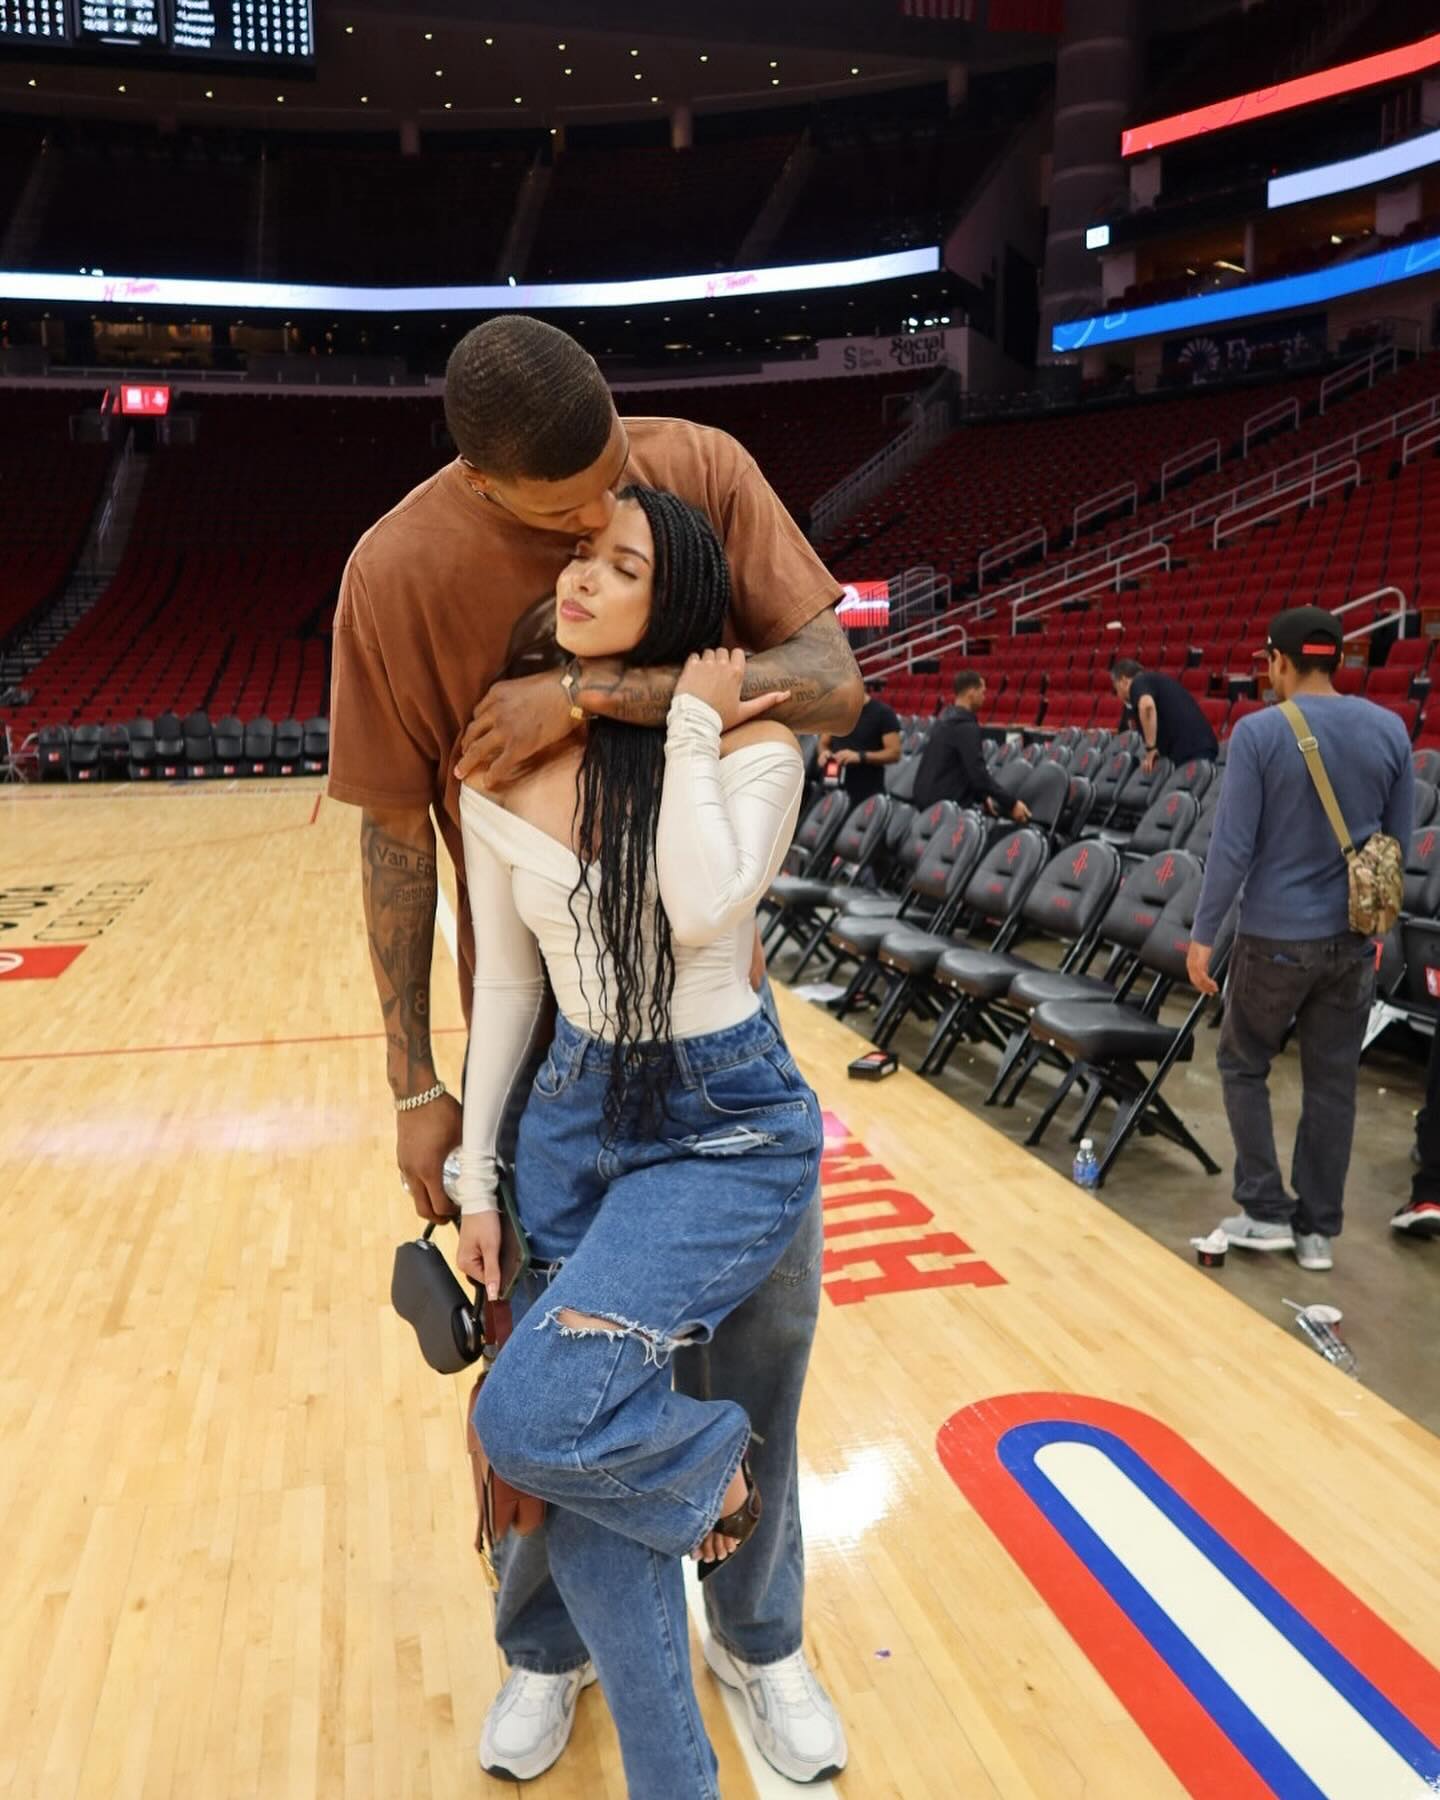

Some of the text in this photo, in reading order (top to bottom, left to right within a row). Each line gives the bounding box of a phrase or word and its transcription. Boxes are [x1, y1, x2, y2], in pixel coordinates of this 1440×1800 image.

[890, 332, 945, 357] Social
[897, 349, 939, 366] Club
[376, 845, 408, 867] Van
